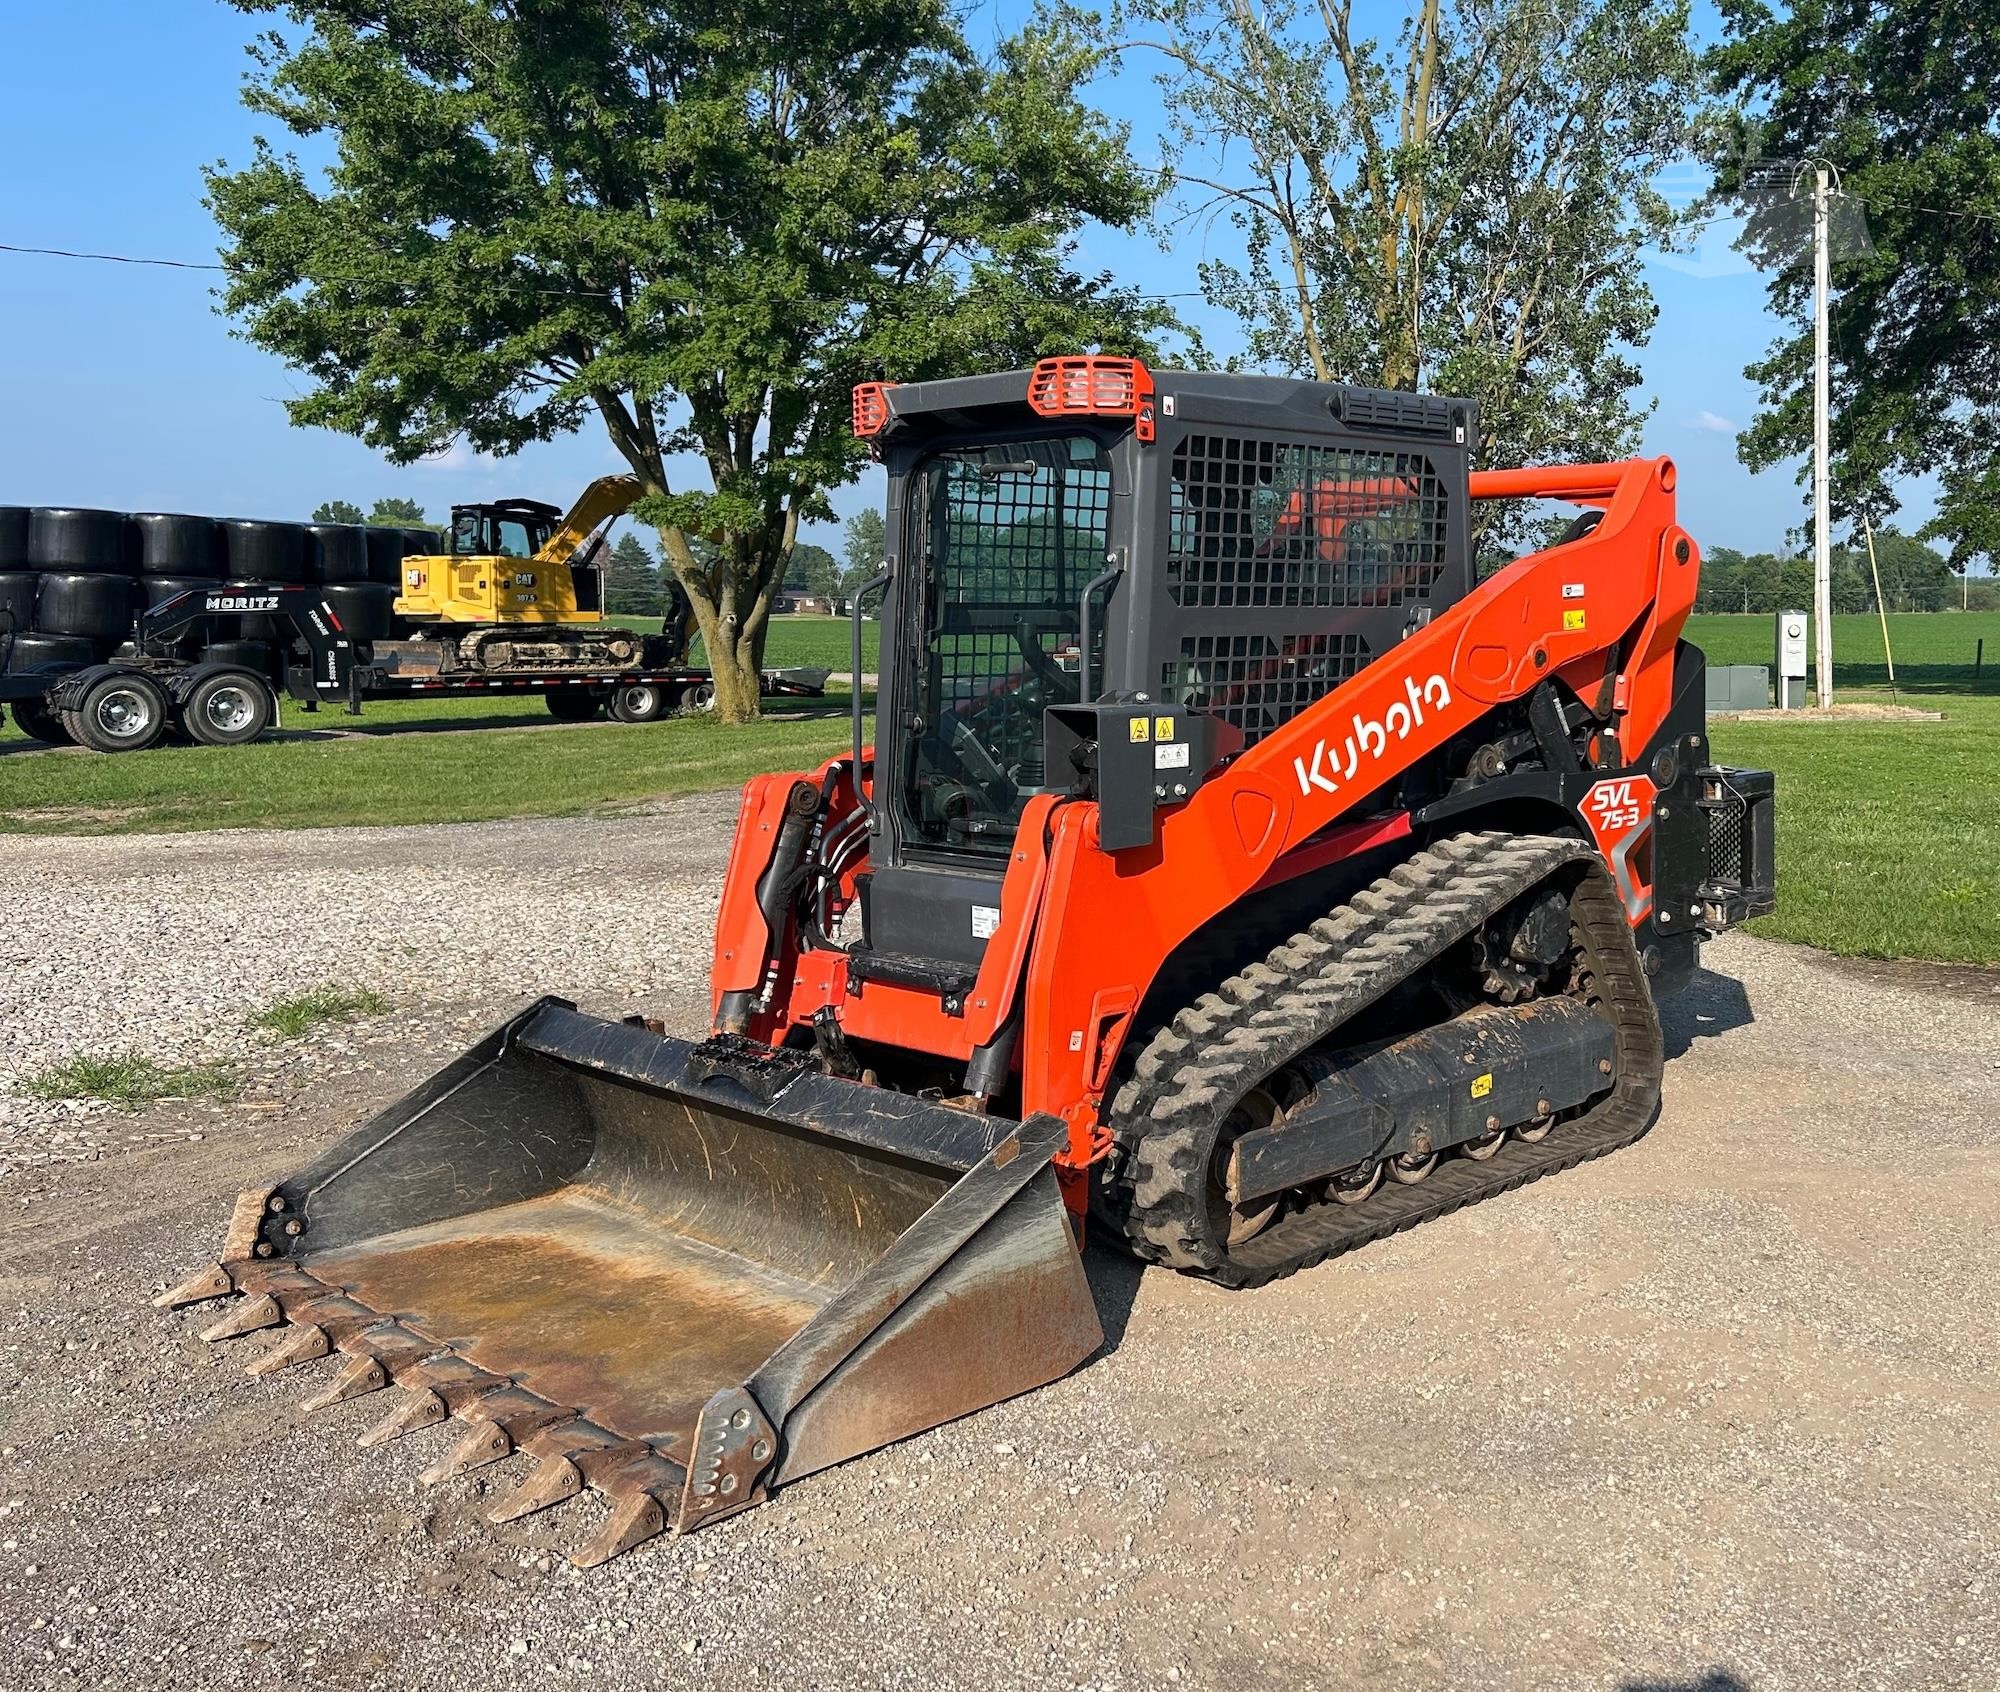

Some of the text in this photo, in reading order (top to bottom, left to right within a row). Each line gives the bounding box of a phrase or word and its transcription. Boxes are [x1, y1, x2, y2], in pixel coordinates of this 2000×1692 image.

[515, 573, 533, 585] CAT
[206, 596, 279, 610] MORITZ
[308, 609, 330, 636] TORQUE
[328, 650, 337, 681] CHASSIS
[1293, 674, 1452, 797] Kubota
[1591, 782, 1638, 812] SVL
[1599, 806, 1640, 831] 75-3
